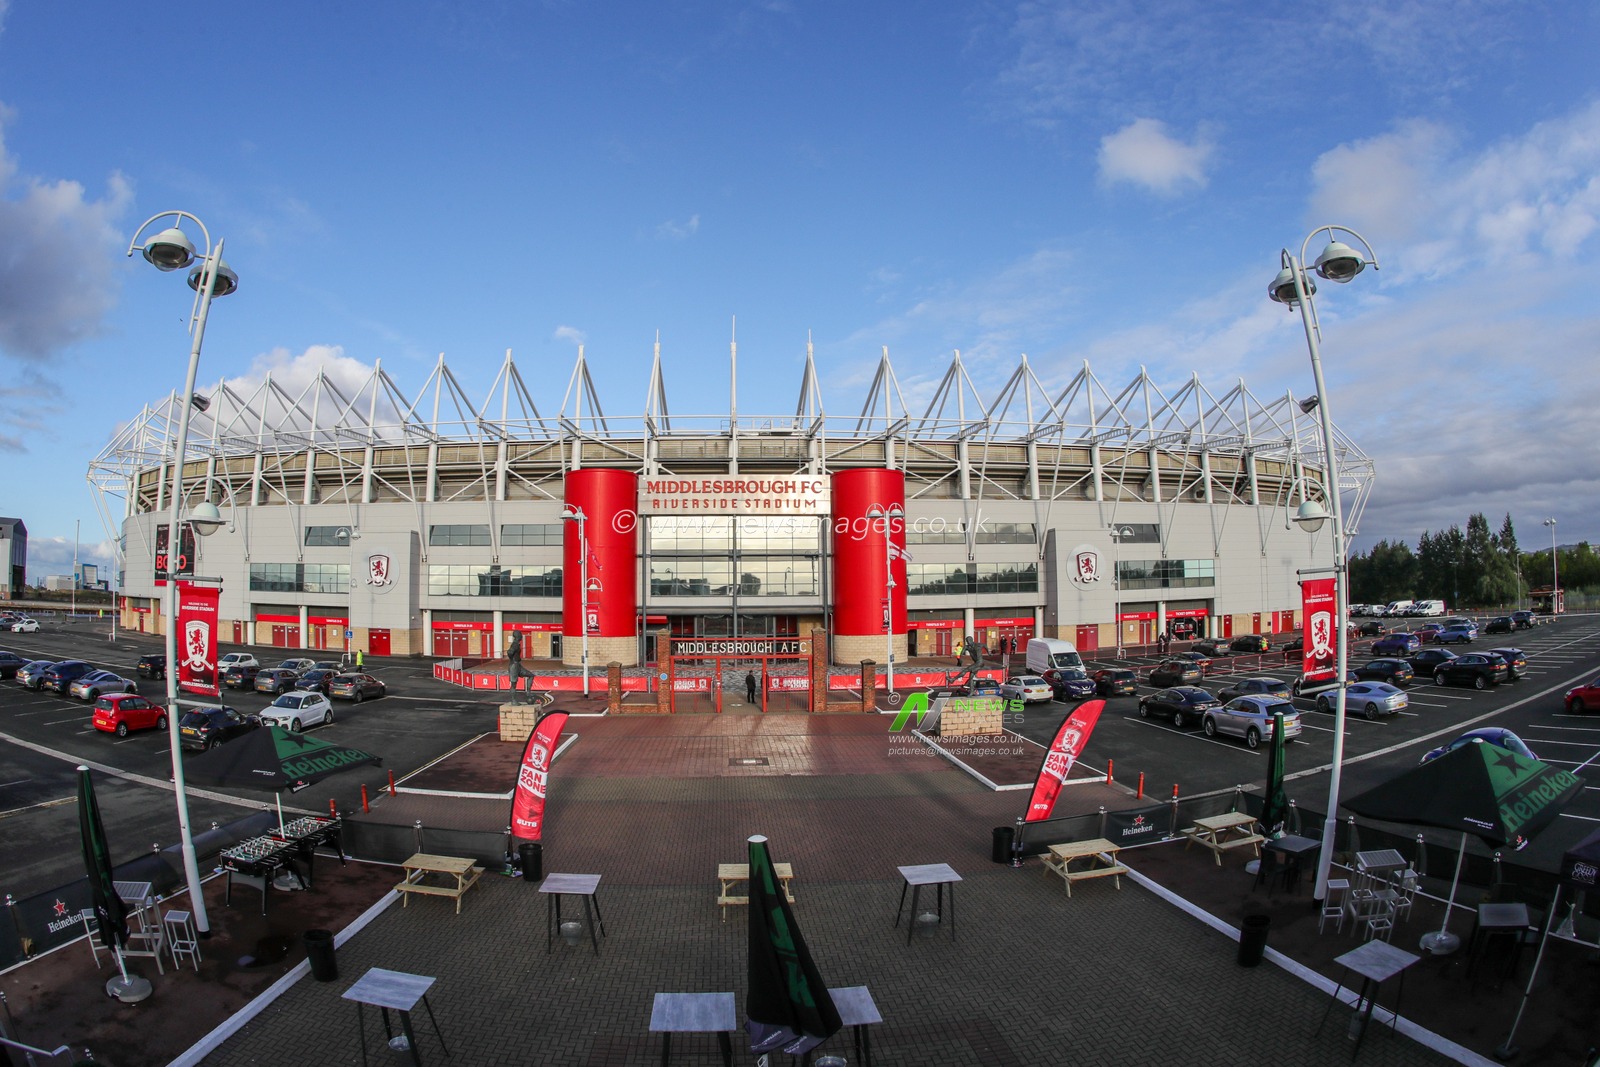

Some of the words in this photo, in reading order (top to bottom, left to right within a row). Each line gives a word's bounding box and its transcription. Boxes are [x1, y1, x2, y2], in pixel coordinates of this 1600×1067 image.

[647, 480, 796, 494] MIDDLESBROUGH
[801, 480, 823, 494] FC
[652, 498, 738, 509] RIVERSIDE
[745, 498, 817, 509] STADIUM
[677, 642, 772, 654] MIDDLESBROUGH
[781, 641, 807, 653] AFC
[1048, 754, 1069, 766] FAN
[522, 768, 542, 784] FAN
[1045, 760, 1069, 777] ZONE
[520, 775, 547, 794] ZONE
[1499, 770, 1580, 833] Heineken
[1122, 824, 1153, 836] Heineken
[48, 911, 83, 934] Heineken
